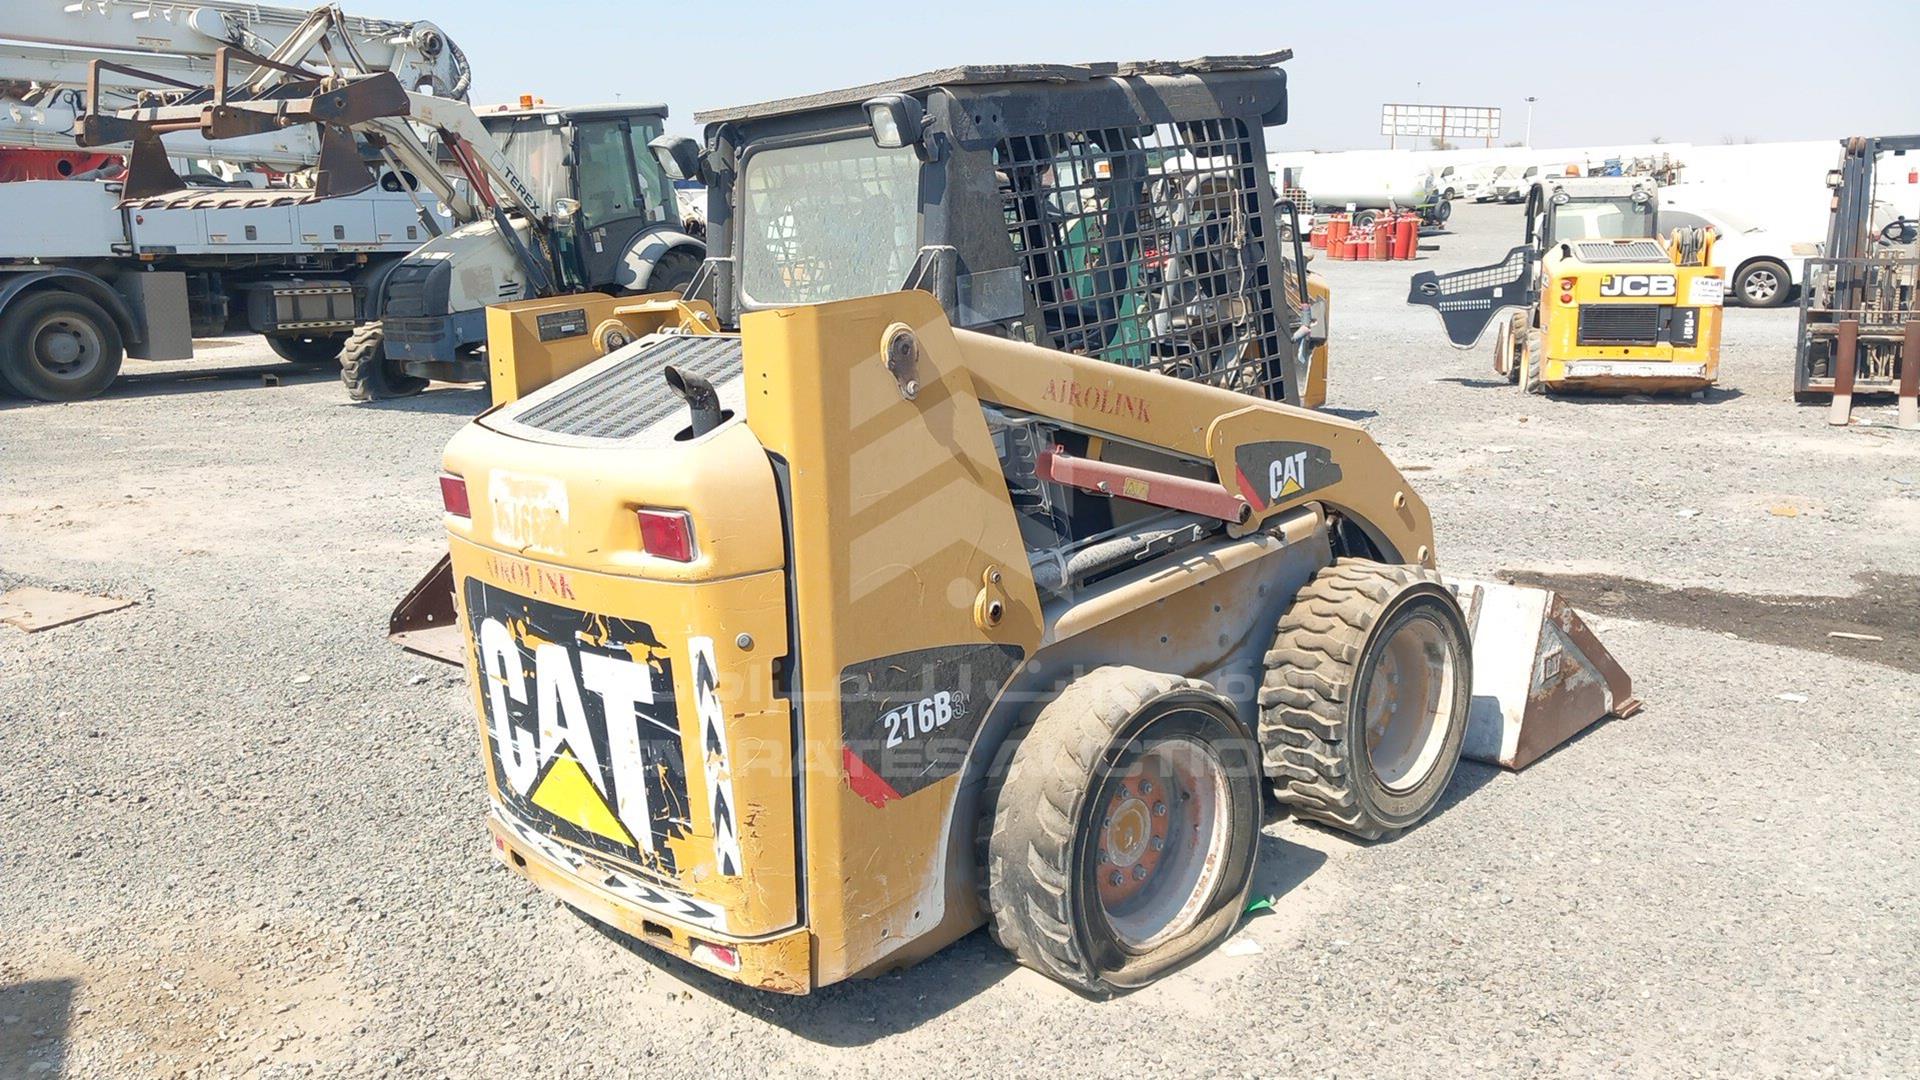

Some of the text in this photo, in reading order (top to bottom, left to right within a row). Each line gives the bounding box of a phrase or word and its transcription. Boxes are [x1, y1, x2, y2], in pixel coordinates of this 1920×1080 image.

[504, 166, 540, 214] TEREX
[1600, 274, 1676, 296] JCB
[1269, 451, 1307, 499] CAT
[481, 618, 654, 856] CAT
